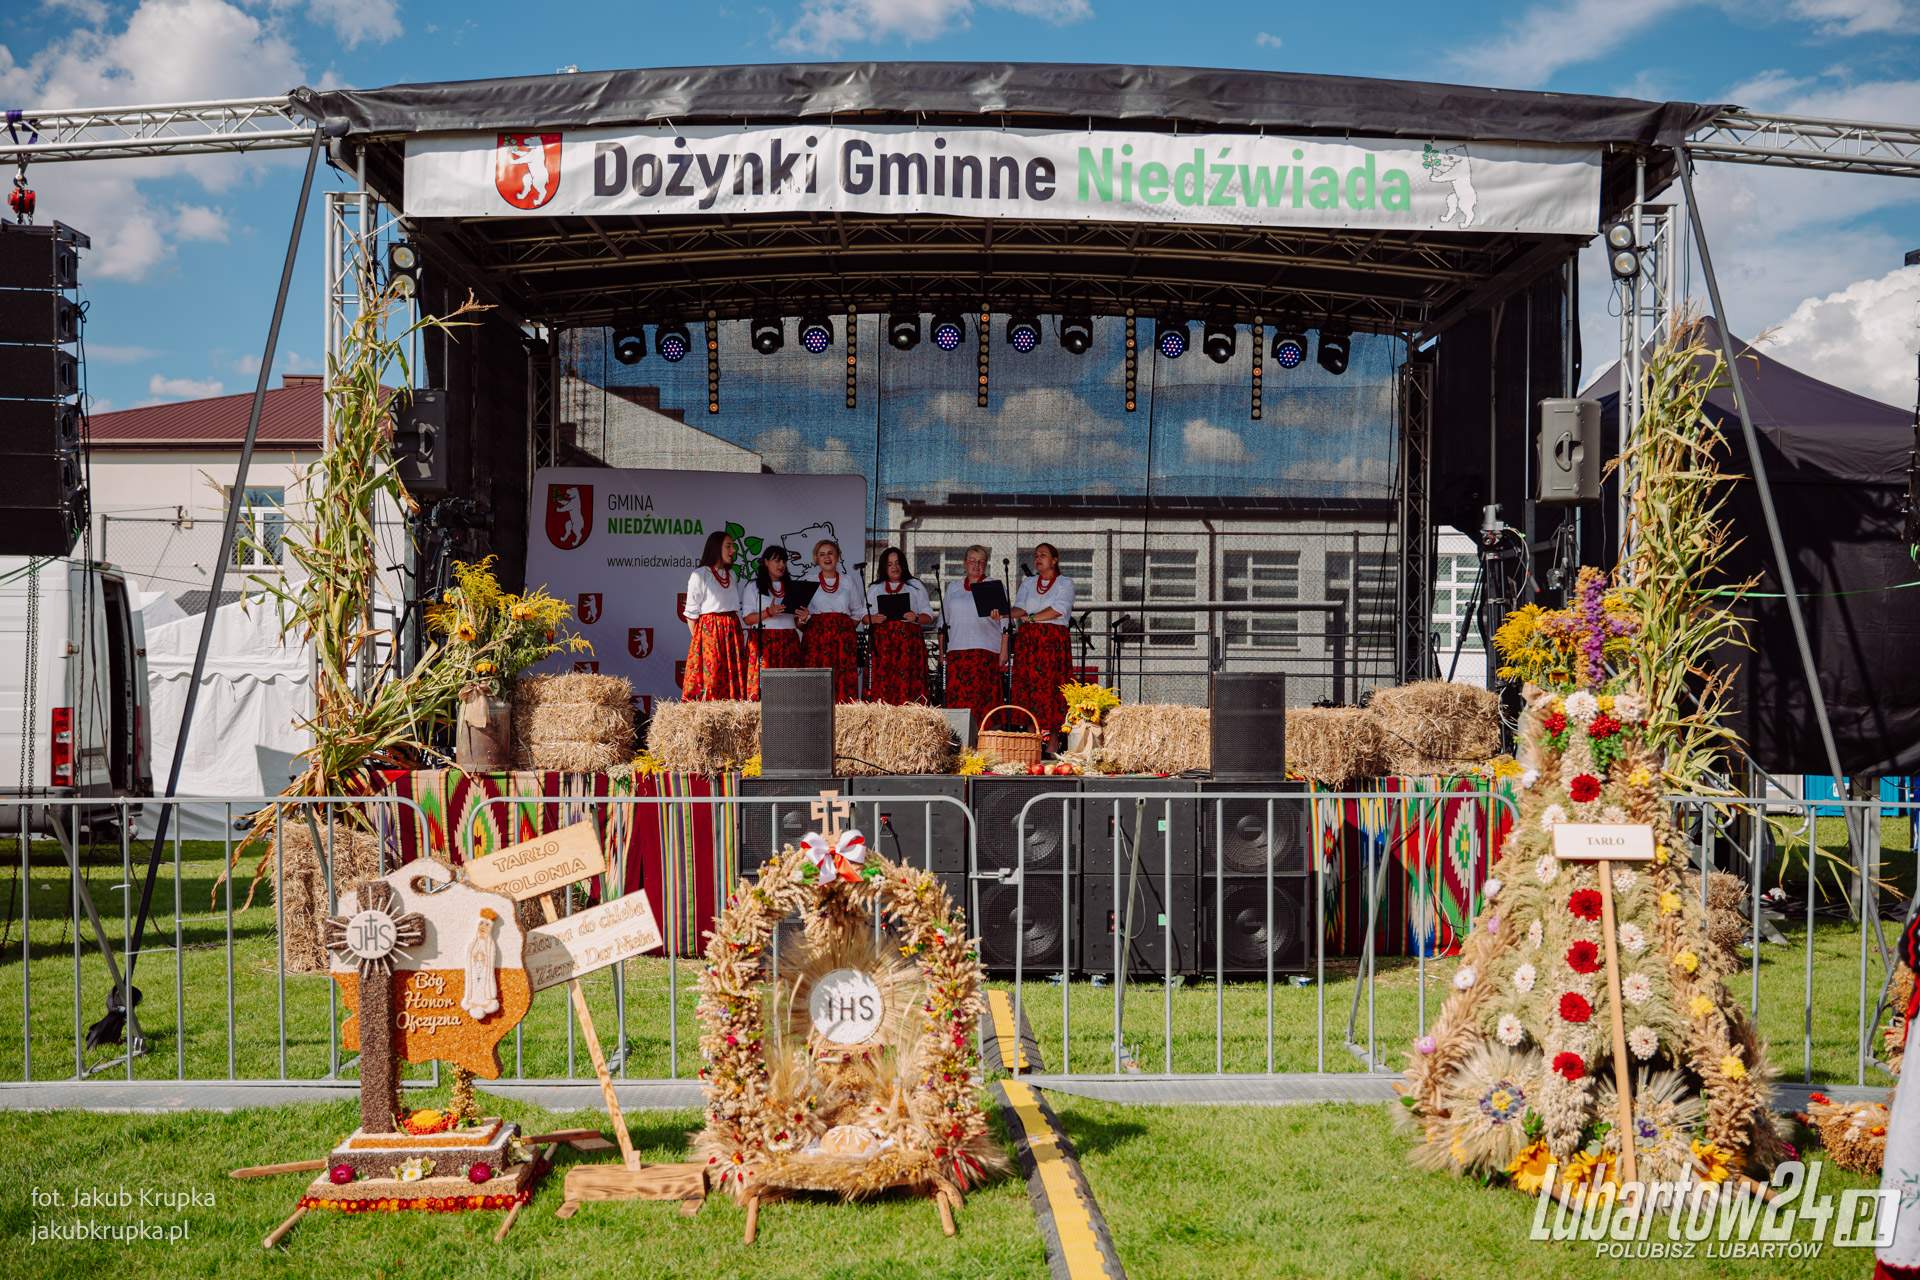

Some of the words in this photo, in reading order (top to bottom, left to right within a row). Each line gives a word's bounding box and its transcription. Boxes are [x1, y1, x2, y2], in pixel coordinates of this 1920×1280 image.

[593, 135, 818, 209] Dożynki
[839, 137, 1057, 200] Gminne
[1076, 144, 1412, 212] Niedźwiada
[608, 493, 654, 511] GMINA
[607, 513, 704, 535] NIEDŹWIADA
[607, 555, 702, 569] www.niedzwiada.p
[493, 840, 560, 873] TARŁO
[495, 857, 587, 897] KOLONIA
[414, 971, 446, 995] Bóg
[404, 991, 456, 1009] Honor
[828, 995, 874, 1022] IHS
[396, 1011, 462, 1035] Ojczyzna
